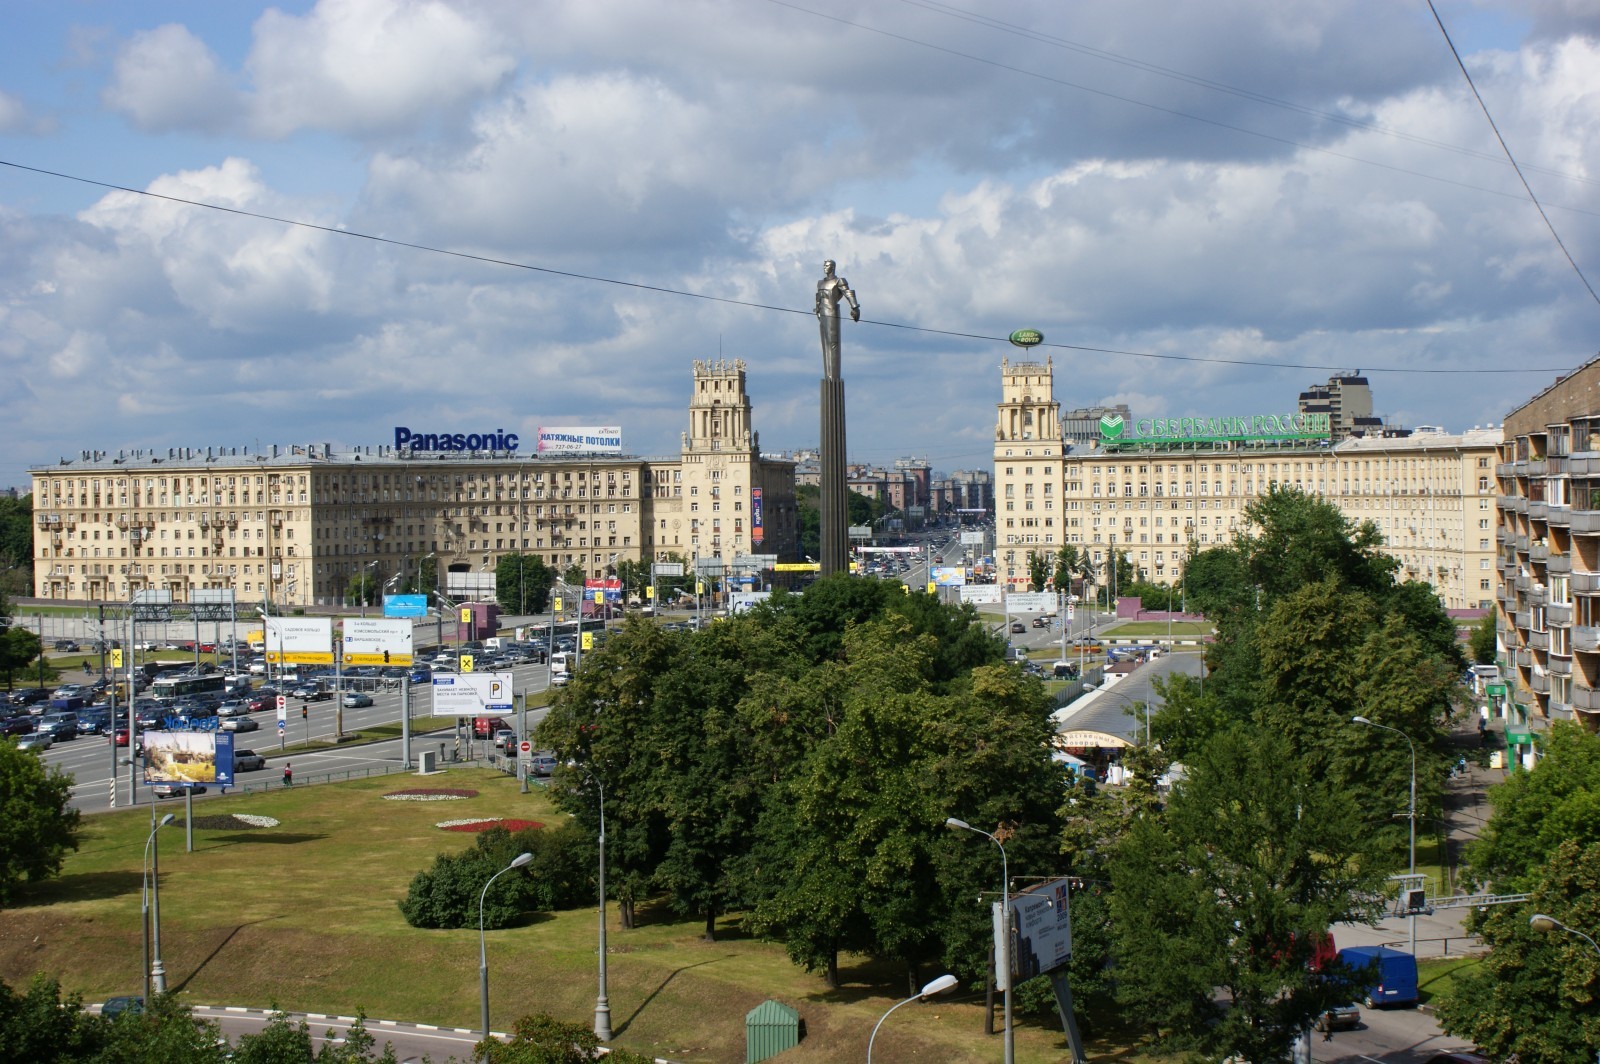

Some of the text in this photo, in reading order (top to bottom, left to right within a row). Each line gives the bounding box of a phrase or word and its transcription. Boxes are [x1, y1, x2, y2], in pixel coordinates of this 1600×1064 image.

[1136, 413, 1330, 437] СБЕРБАНК РОССИИ
[395, 427, 519, 450] Panasonic
[541, 434, 620, 446] НАТЯЖНЫЕ ПОТОЛКИ
